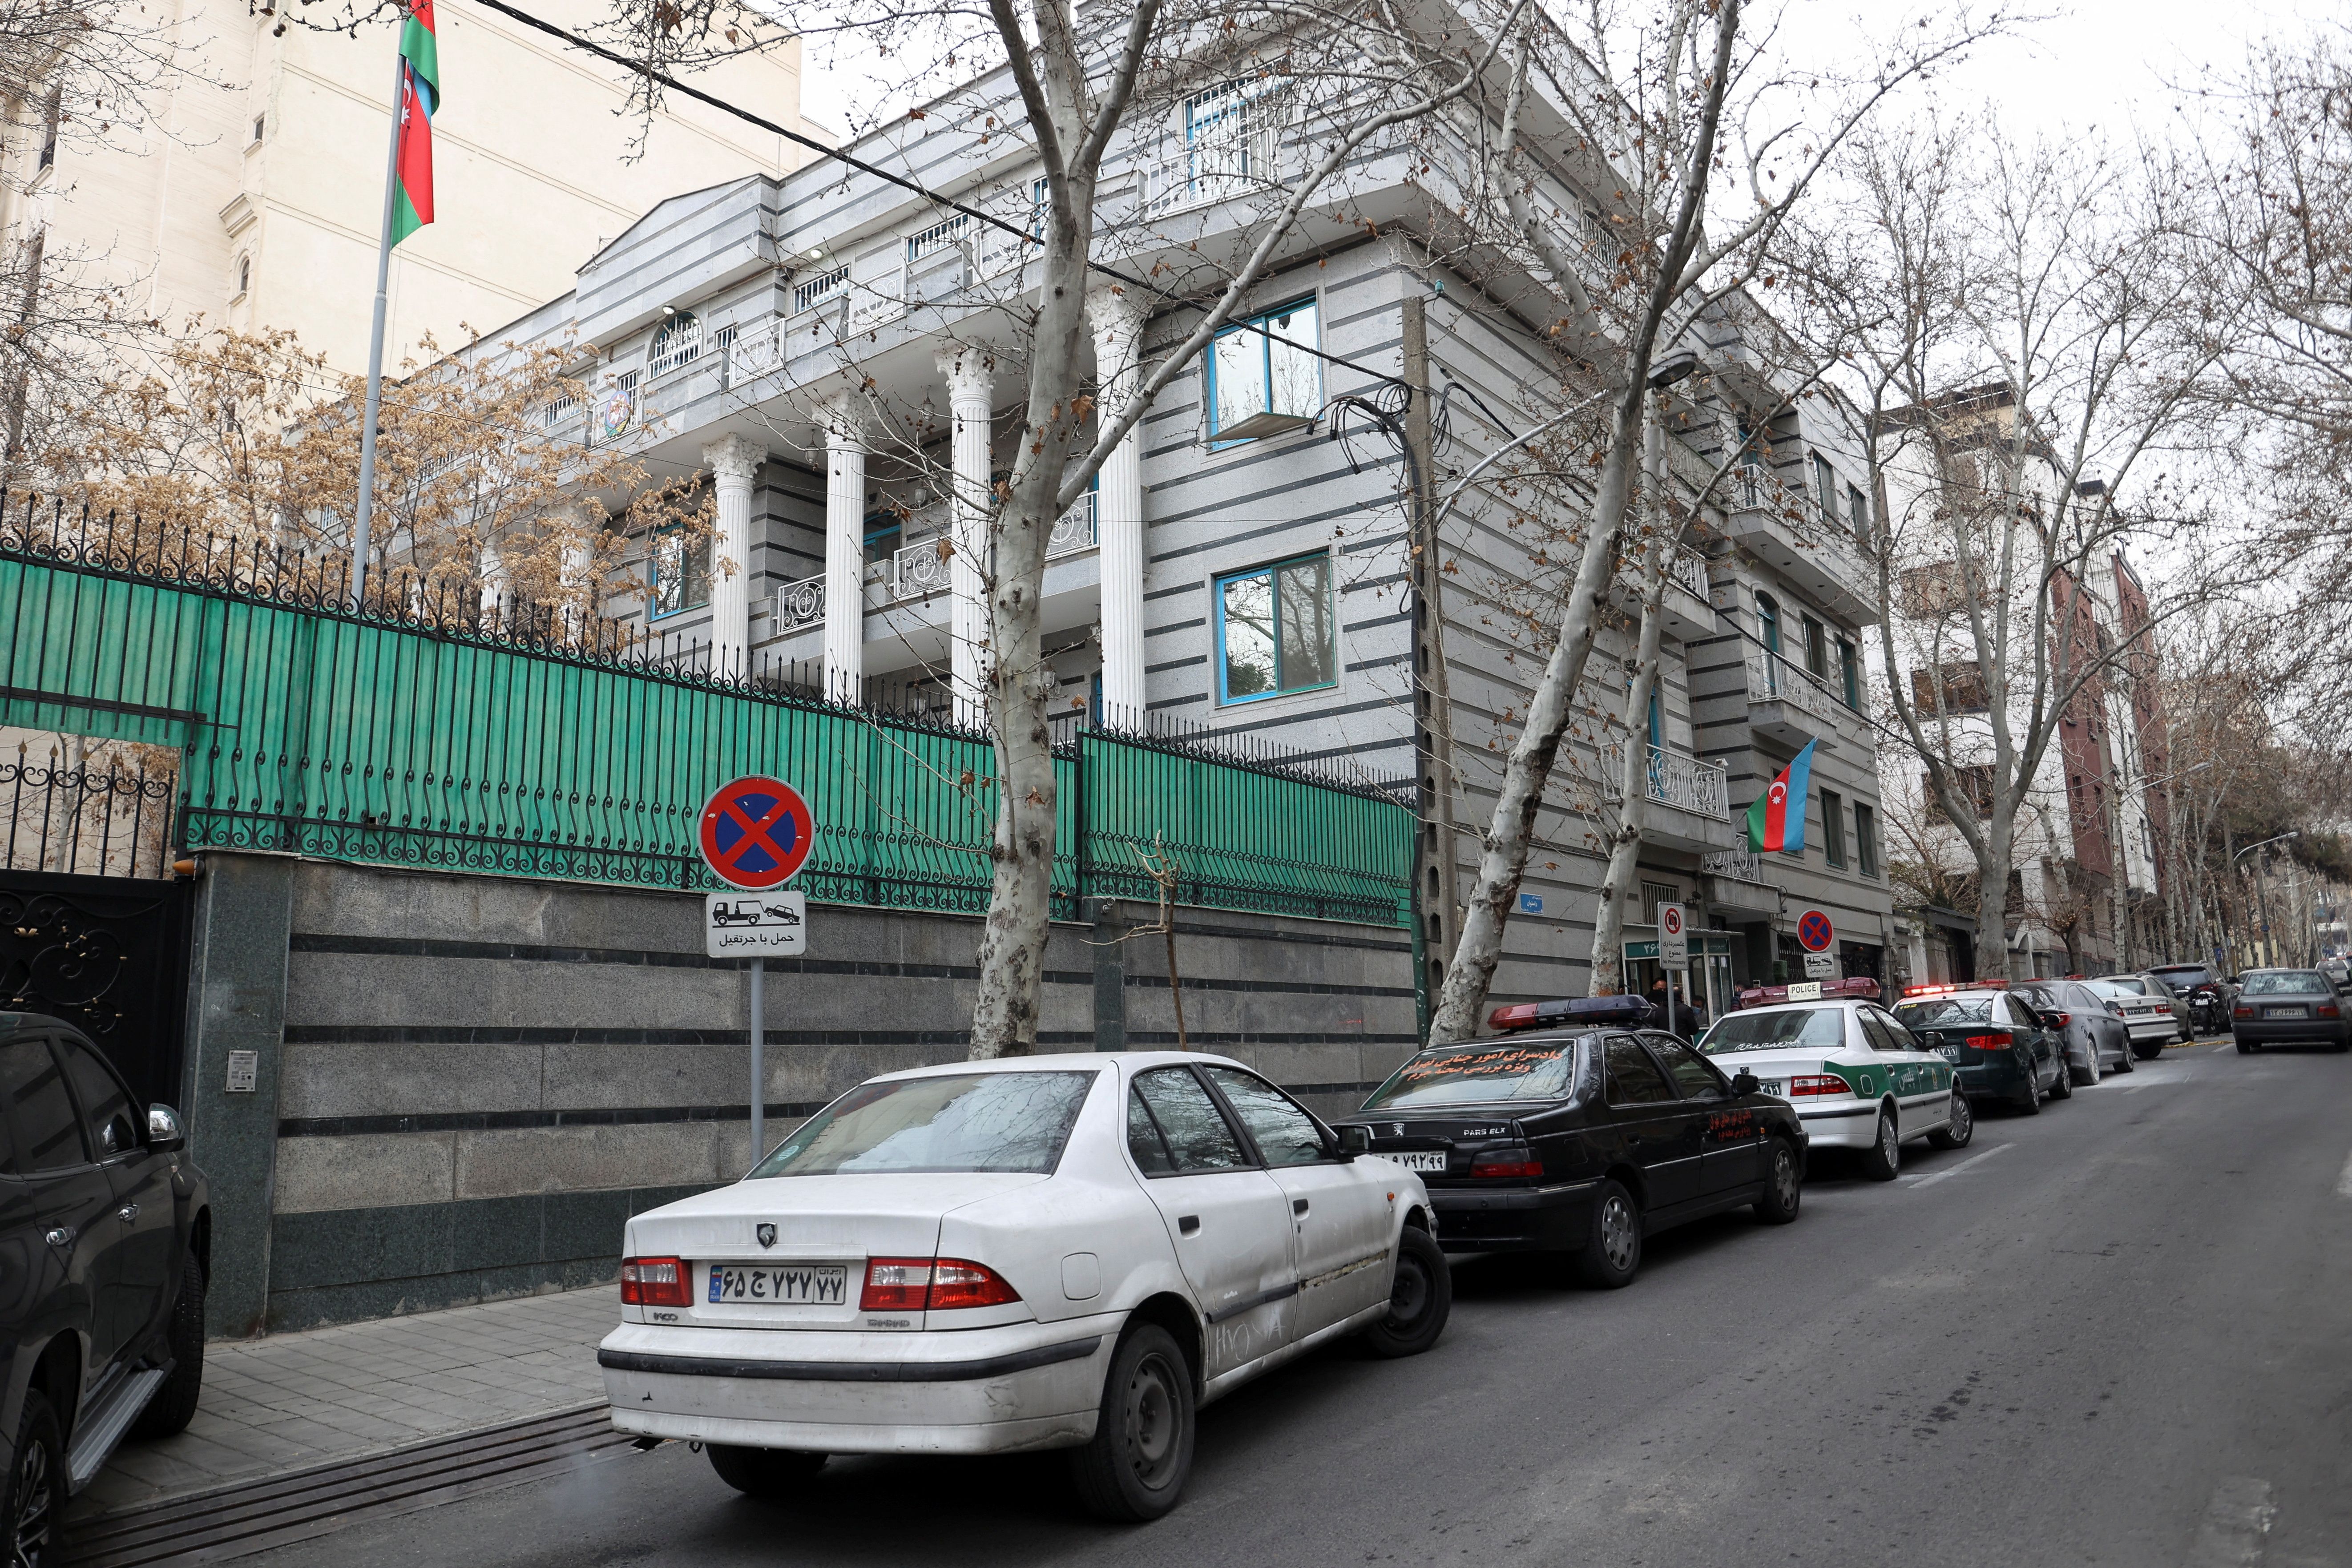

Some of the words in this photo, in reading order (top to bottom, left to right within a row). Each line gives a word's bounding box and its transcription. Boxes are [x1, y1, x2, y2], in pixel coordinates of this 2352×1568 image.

[759, 933, 767, 945] با
[771, 932, 795, 946] حمل
[1668, 950, 1681, 958] ممنوع
[1791, 984, 1816, 994] POLICE
[1434, 1054, 1473, 1067] جنایی
[1472, 1050, 1506, 1063] امور
[1503, 1049, 1563, 1061] دادسرای
[1401, 1057, 1437, 1074] تهران
[1463, 1064, 1503, 1074] بررسی
[1505, 1062, 1531, 1073] ویژه
[1406, 1070, 1432, 1082] جرم
[1898, 1067, 1915, 1091] پلیس
[1403, 1154, 1427, 1169] ۷۹۲
[1429, 1156, 1444, 1169] ۹۹
[722, 1270, 746, 1298] ۶۵
[750, 1270, 767, 1298] ج
[772, 1270, 811, 1298] ۷۲۷
[816, 1277, 842, 1301] ۷۷
